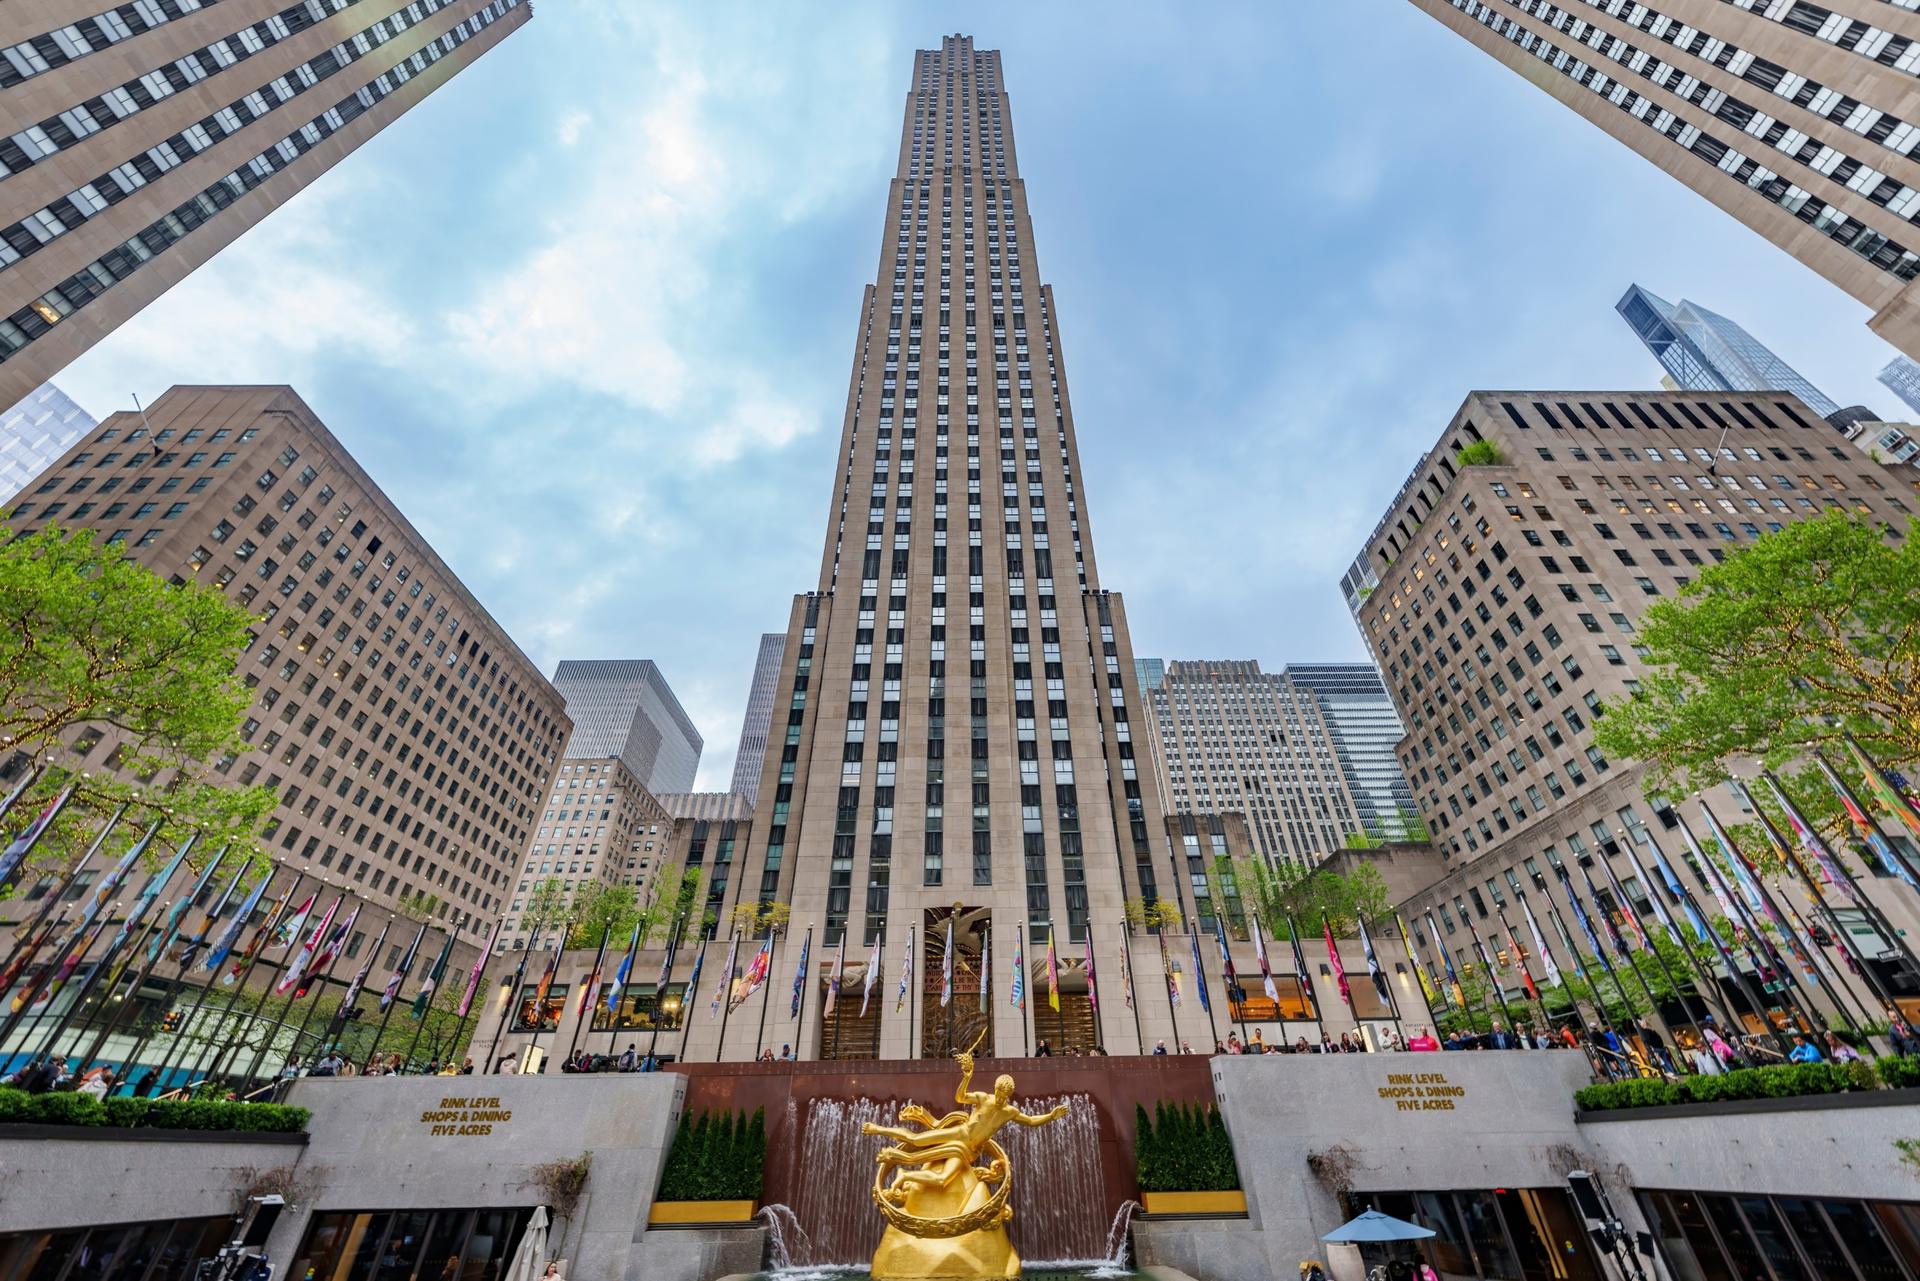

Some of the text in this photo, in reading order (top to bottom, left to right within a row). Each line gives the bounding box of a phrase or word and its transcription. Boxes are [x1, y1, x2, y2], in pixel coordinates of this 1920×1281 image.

[1387, 1073, 1447, 1084] RINK LEVEL
[1378, 1086, 1465, 1098] SHOPS & DINING
[440, 1097, 501, 1108] RINK LEVEL
[1396, 1099, 1455, 1111] FIVE ACRES
[420, 1110, 512, 1122] SHOPS & DINING
[430, 1124, 493, 1136] FIVE ACRES
